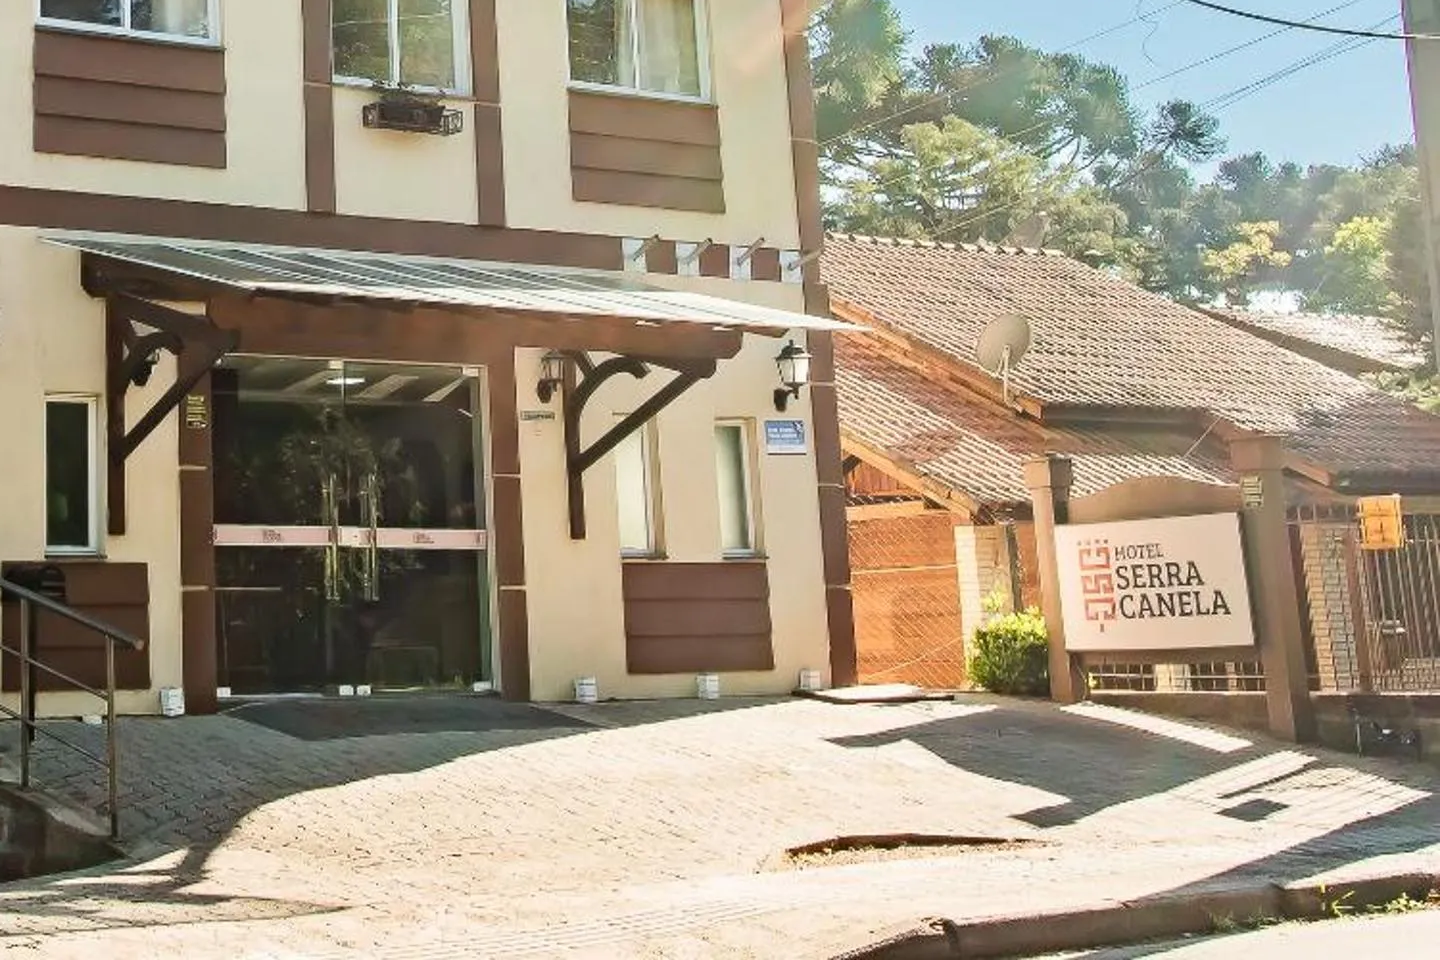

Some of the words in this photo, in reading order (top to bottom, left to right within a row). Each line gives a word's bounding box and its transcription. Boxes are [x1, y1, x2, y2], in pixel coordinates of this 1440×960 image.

[1115, 543, 1164, 560] HOTEL
[1116, 561, 1205, 589] SERRA
[1119, 590, 1231, 619] CANELA
